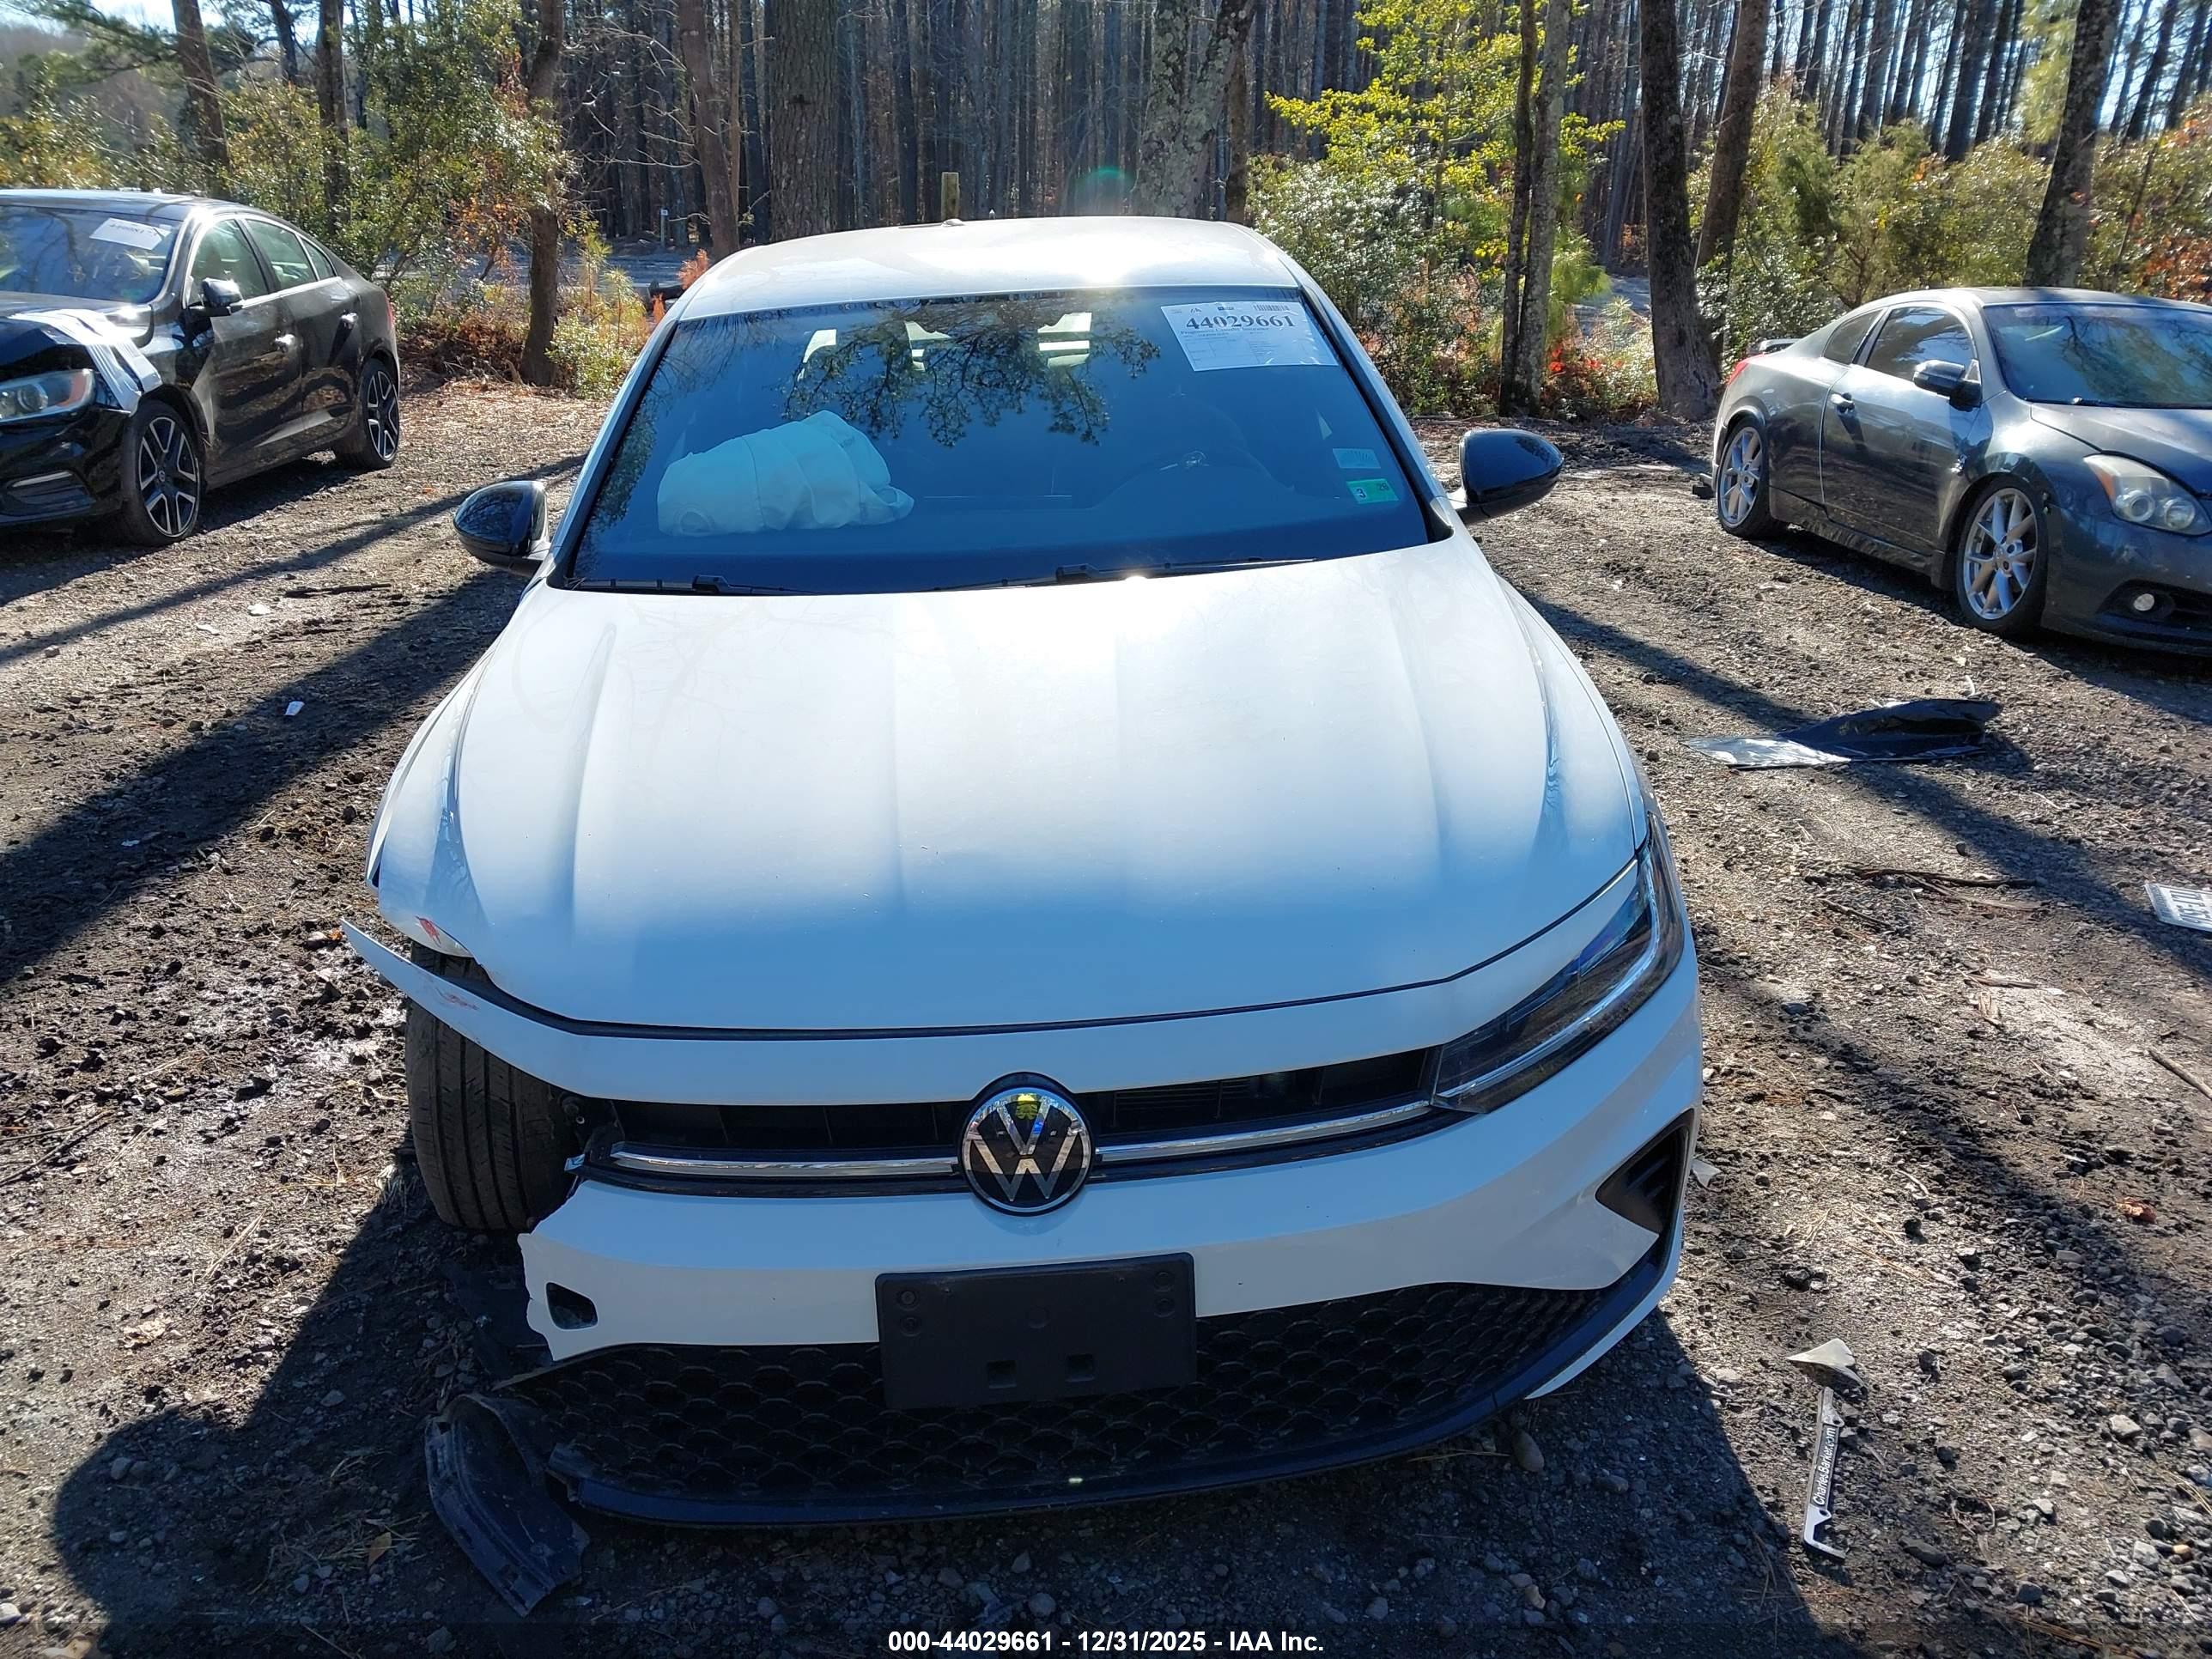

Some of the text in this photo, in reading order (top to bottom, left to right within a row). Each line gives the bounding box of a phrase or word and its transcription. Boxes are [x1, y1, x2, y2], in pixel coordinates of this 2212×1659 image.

[1186, 314, 1296, 330] 44029661
[1356, 488, 1366, 499] 3
[966, 1095, 1087, 1205] VW
[1813, 1427, 1836, 1506] CharlesBarker.com
